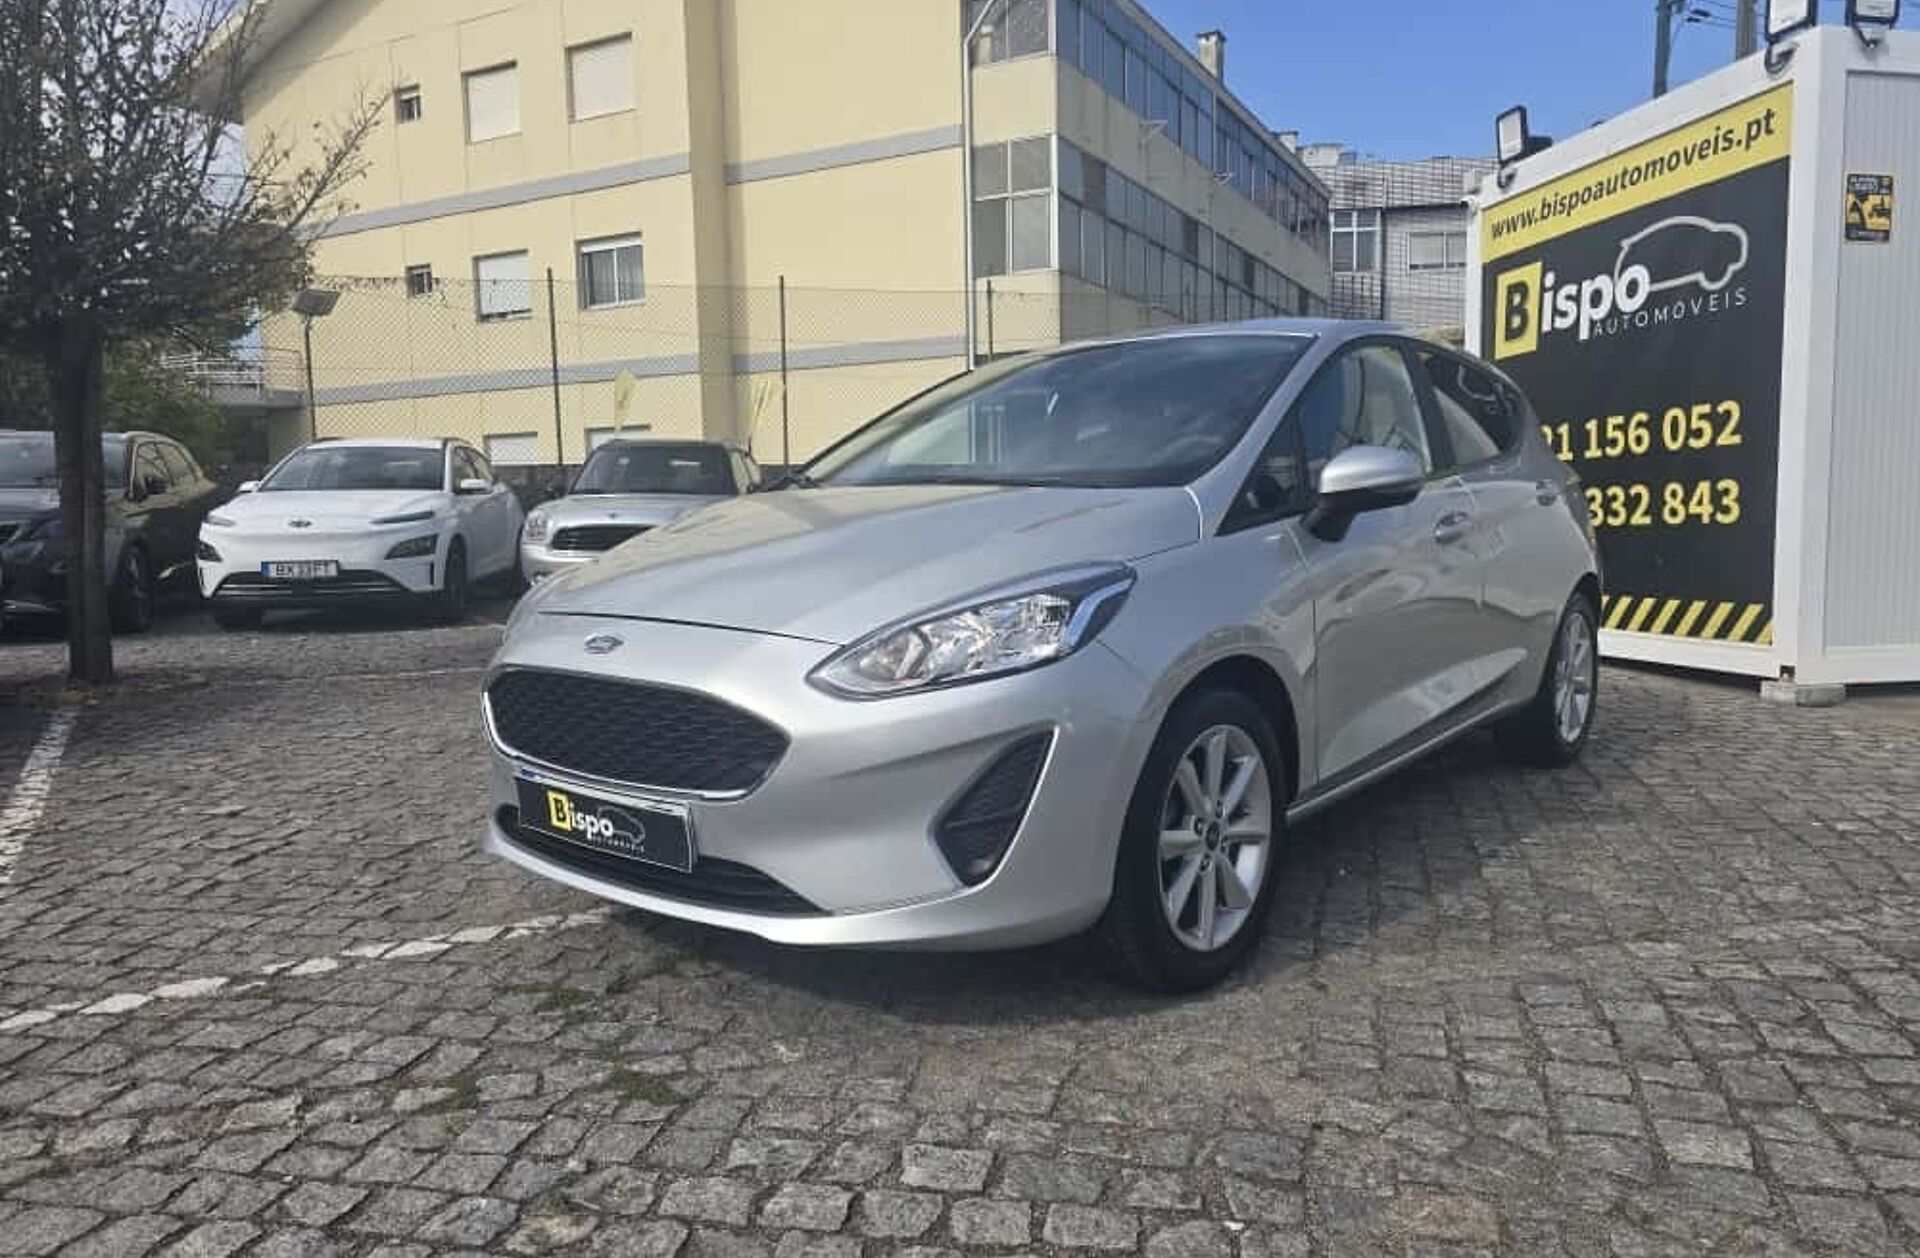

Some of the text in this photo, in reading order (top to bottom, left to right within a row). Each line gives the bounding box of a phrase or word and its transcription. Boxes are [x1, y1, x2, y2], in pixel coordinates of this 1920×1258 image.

[1491, 107, 1776, 241] www.bispoautomoveis.pt
[1503, 264, 1651, 342] Bispo
[1593, 286, 1748, 337] AUTOMOVEIS
[1583, 411, 1651, 459] 156
[1662, 400, 1742, 451] 052
[1585, 478, 1741, 527] 332 843
[552, 795, 614, 840] Bispo
